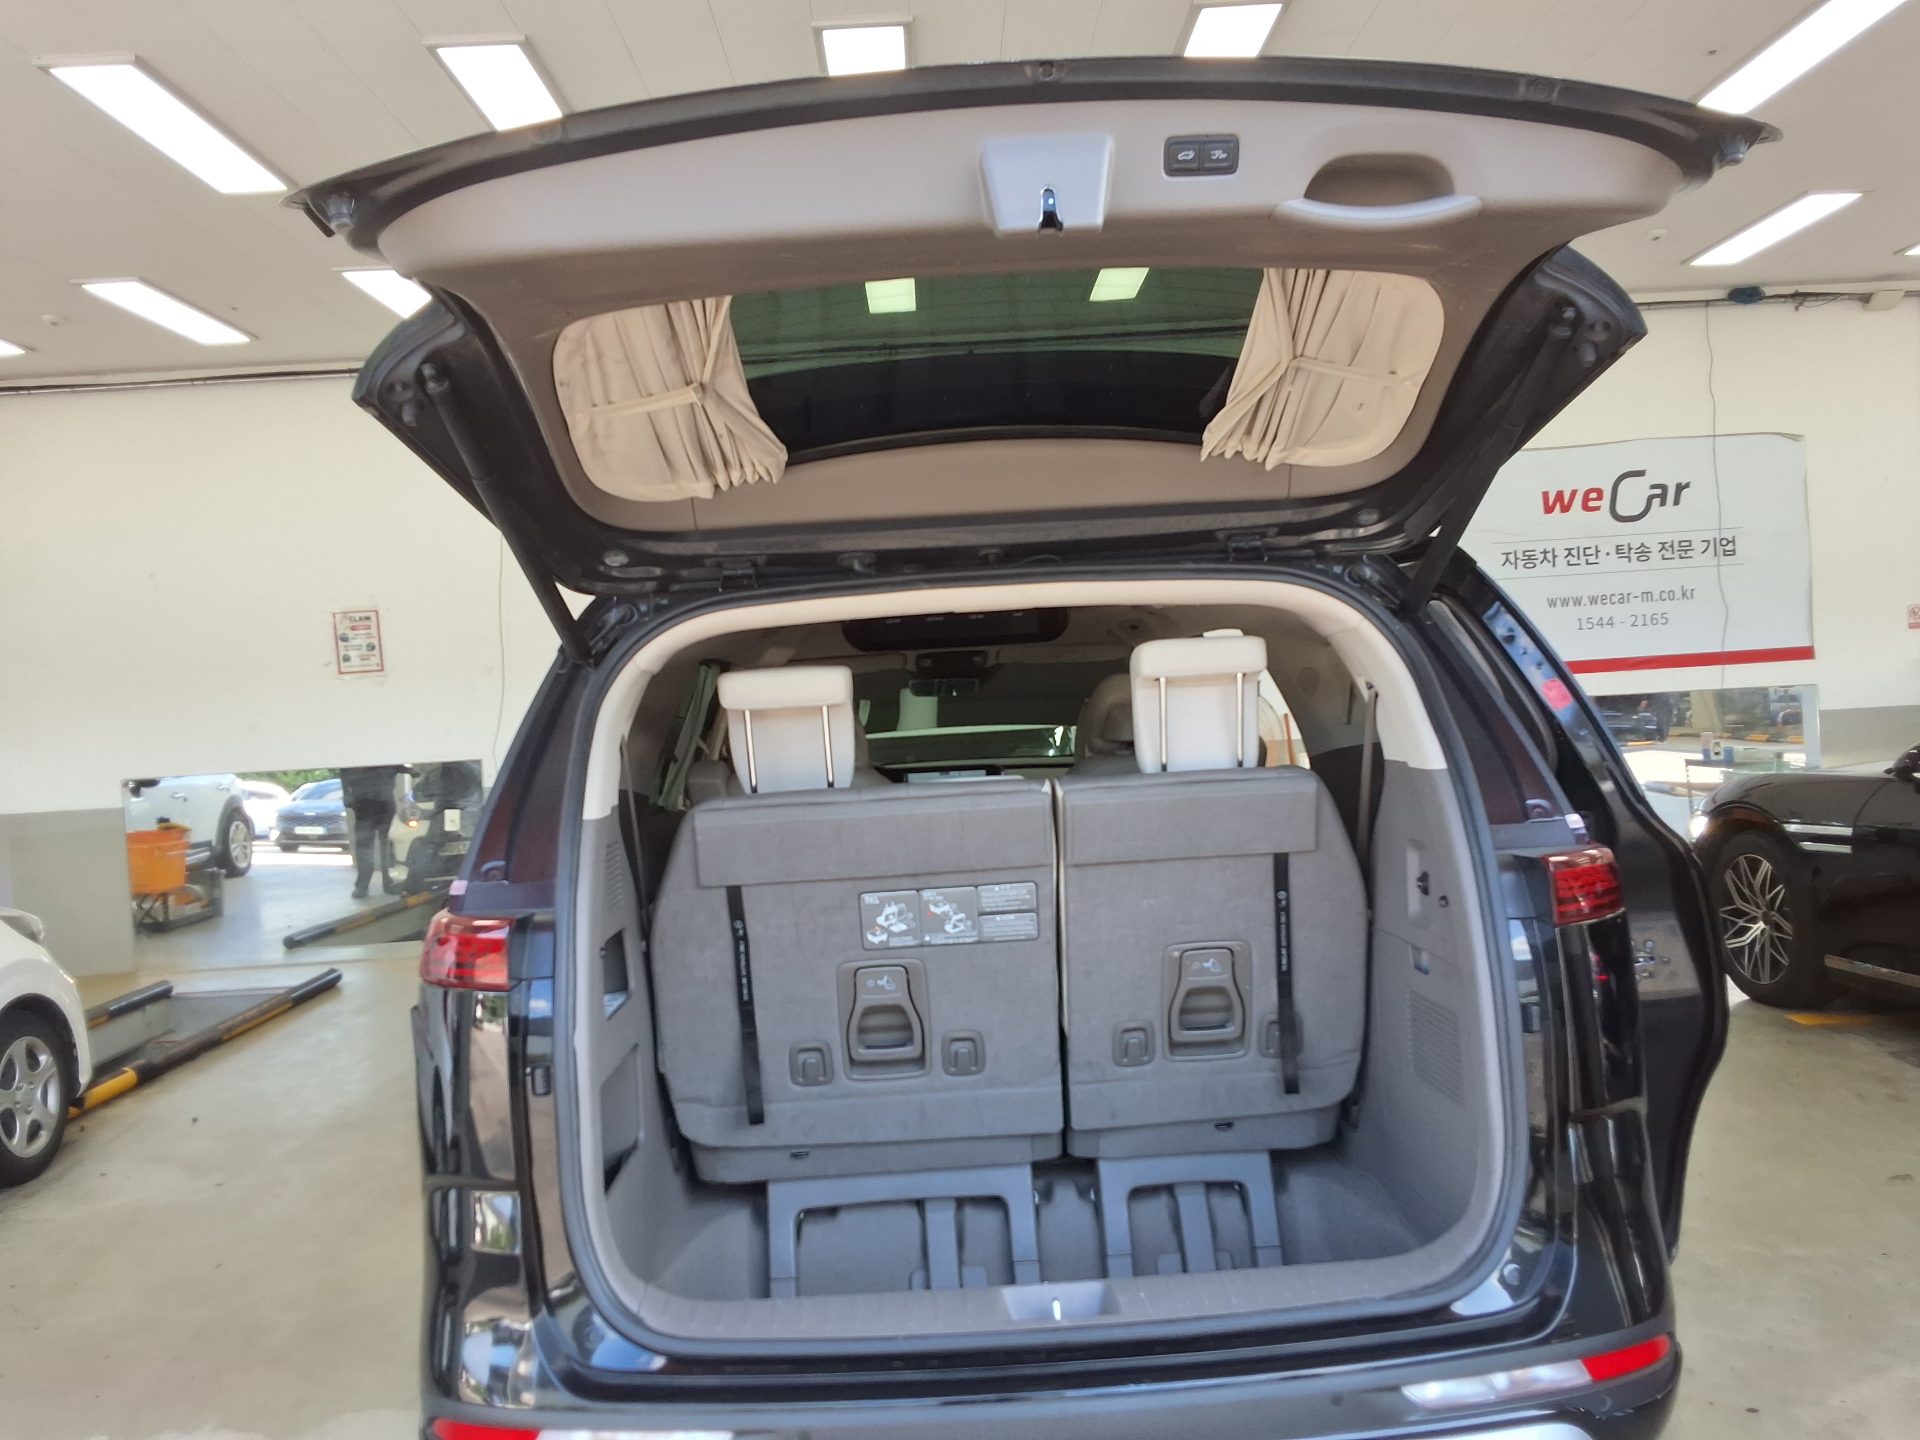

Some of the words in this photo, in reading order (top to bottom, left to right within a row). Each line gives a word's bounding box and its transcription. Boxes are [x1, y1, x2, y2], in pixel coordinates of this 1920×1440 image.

[1541, 469, 1691, 523] weCar
[1501, 547, 1558, 570] 자동차
[1657, 539, 1696, 561] 전문
[1700, 535, 1737, 558] 기업
[1547, 585, 1695, 609] www.wecar-m.co.kr
